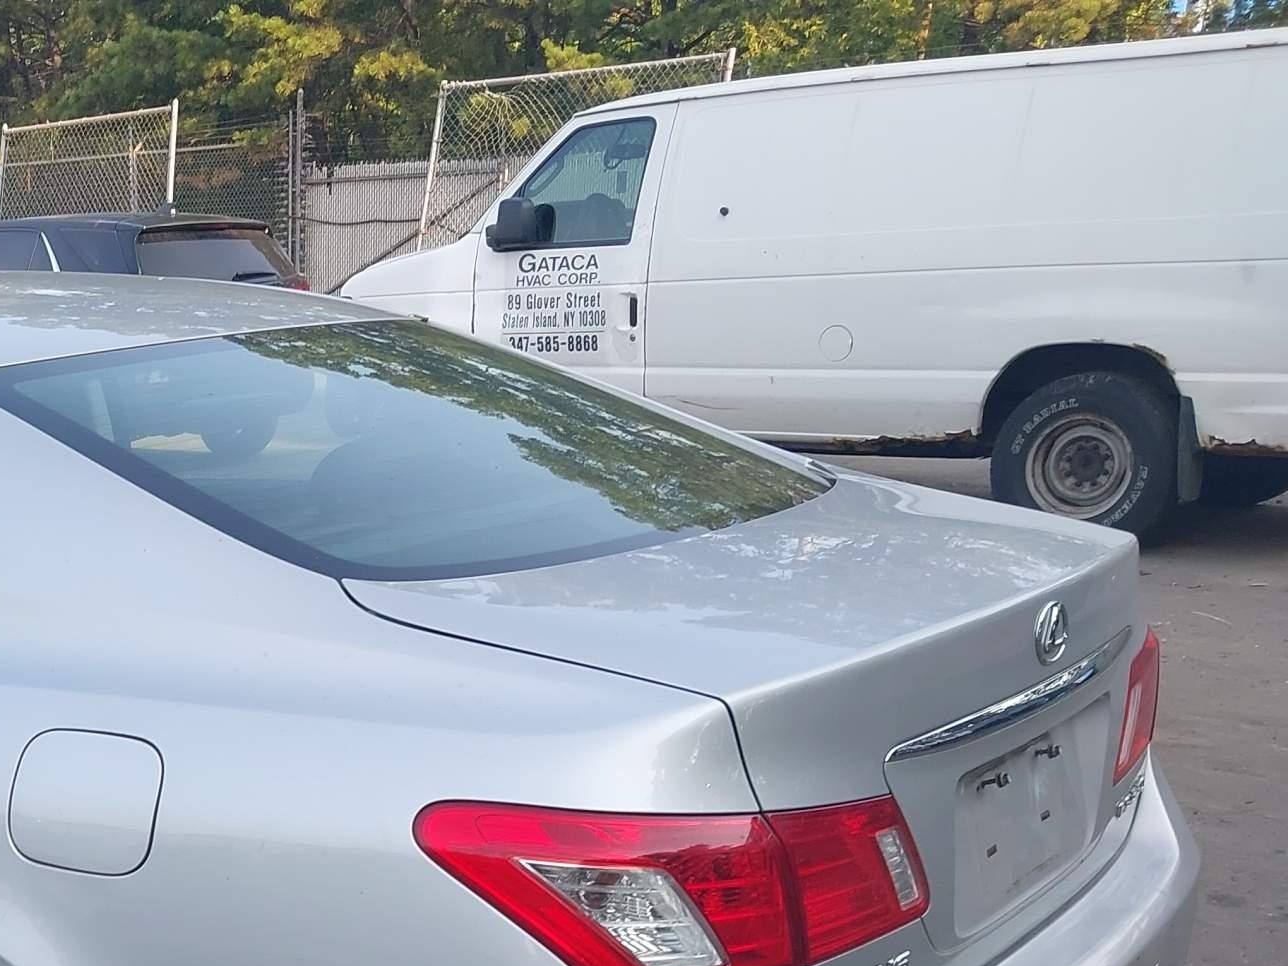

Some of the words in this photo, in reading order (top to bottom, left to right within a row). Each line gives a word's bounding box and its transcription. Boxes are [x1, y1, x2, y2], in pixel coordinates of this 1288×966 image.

[516, 274, 551, 287] HVAC
[557, 272, 601, 286] CORP.
[507, 294, 521, 310] 89
[526, 293, 561, 310] Glover
[566, 292, 601, 308] Street
[501, 313, 529, 329] Staten
[563, 311, 575, 327] NY
[578, 310, 607, 327] 10308
[508, 334, 599, 352] 347-585-8868
[1023, 398, 1080, 434] RADIAL
